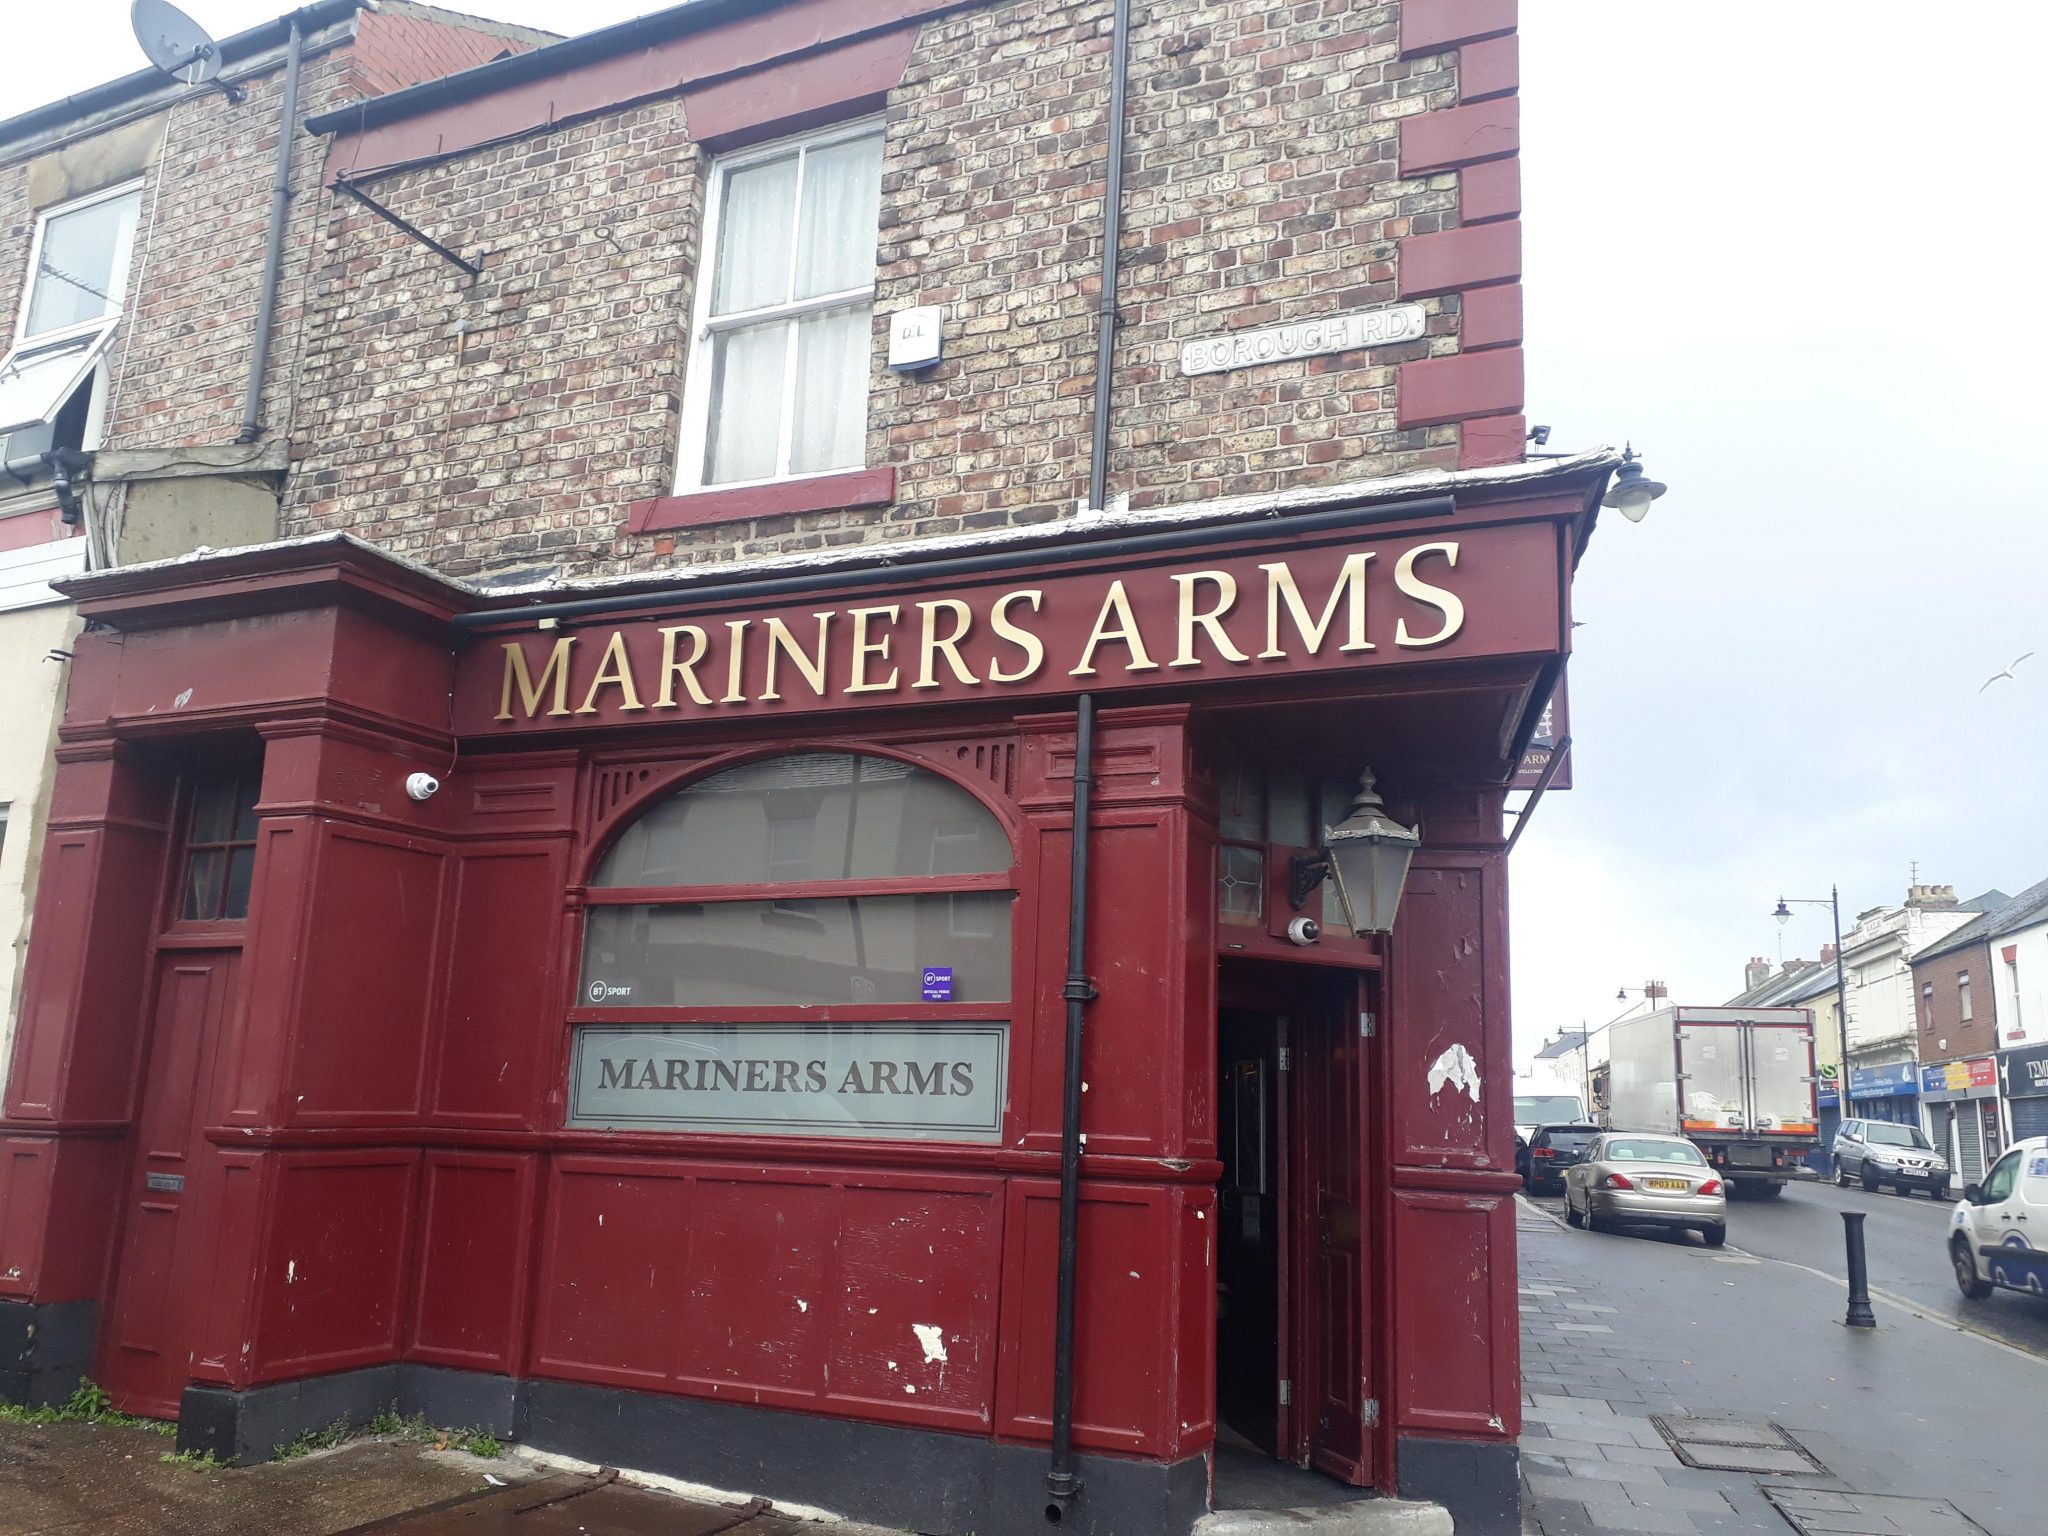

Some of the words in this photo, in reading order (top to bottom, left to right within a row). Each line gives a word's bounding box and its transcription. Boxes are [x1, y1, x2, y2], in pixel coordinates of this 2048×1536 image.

[1189, 320, 1349, 371] BOROUGH
[1361, 310, 1410, 343] RD
[493, 589, 1044, 720] MARINERS
[1068, 541, 1465, 676] ARMS
[1523, 754, 1551, 764] ARM
[607, 986, 632, 996] SPORT
[597, 1058, 828, 1095] MARINERS
[837, 1060, 975, 1097] ARMS
